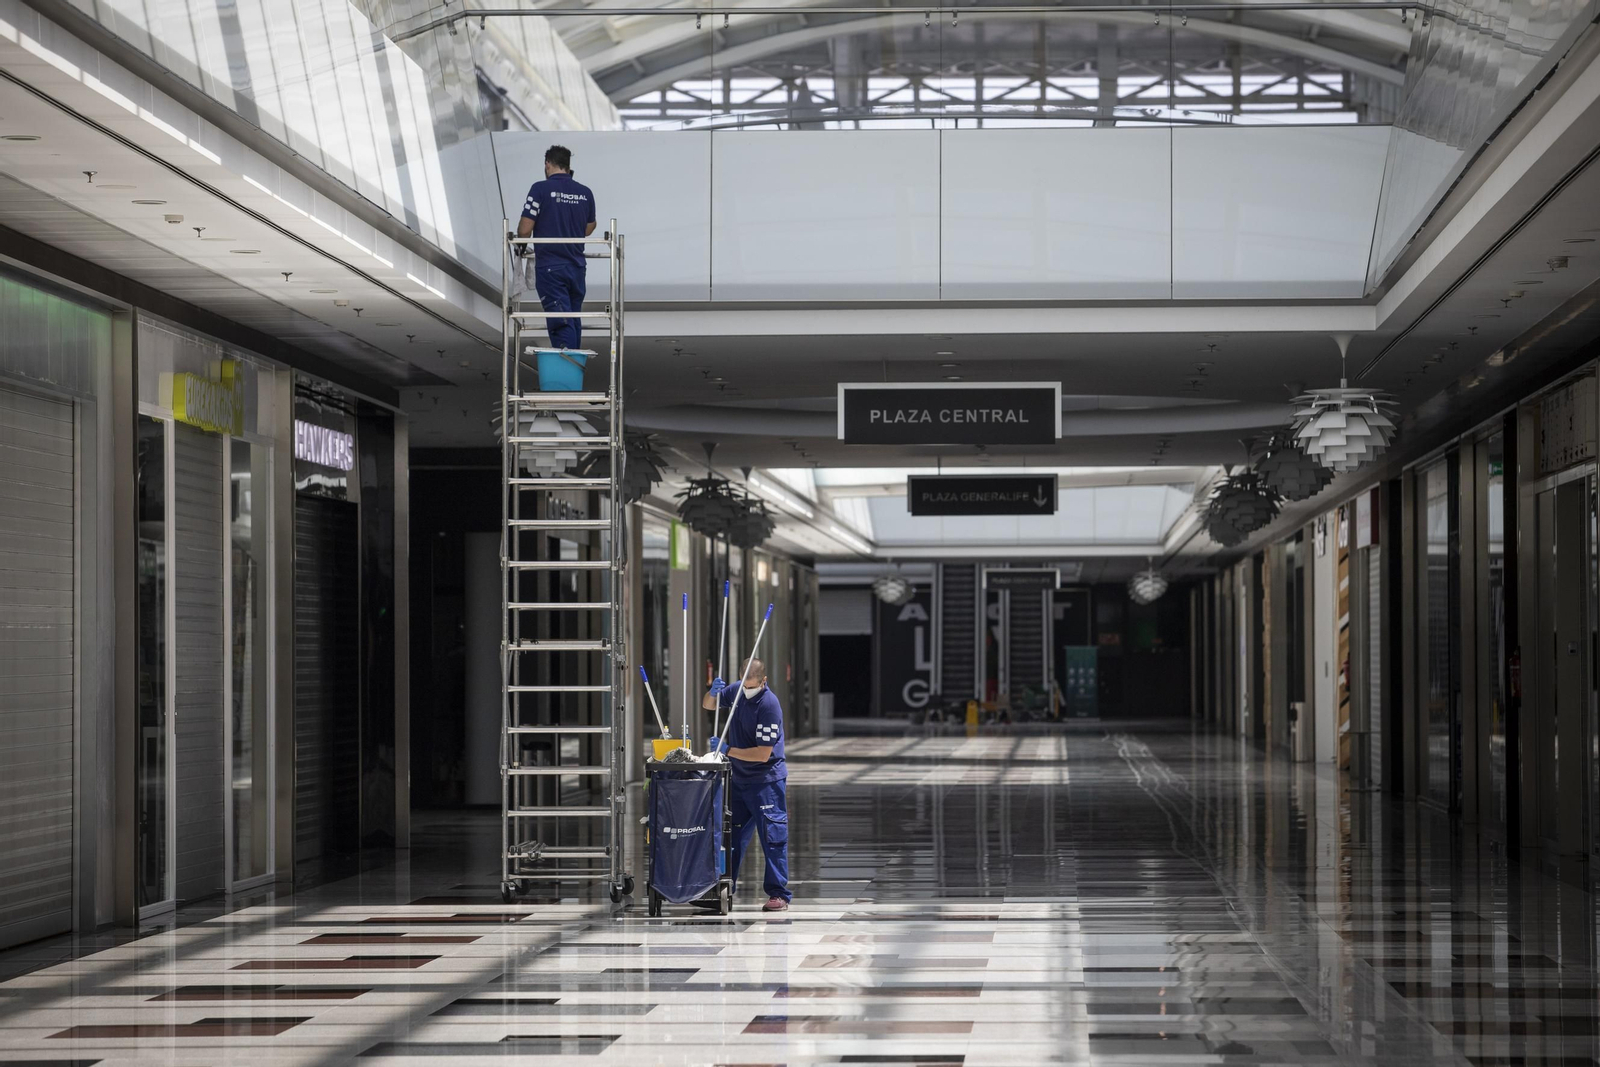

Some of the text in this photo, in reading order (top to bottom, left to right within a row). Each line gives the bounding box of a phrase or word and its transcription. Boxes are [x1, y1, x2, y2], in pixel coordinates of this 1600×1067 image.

[870, 409, 1029, 423] PLAZA CENTRAL
[294, 418, 354, 471] HAWKERS
[922, 491, 1030, 502] PLAZA GENERALIFE
